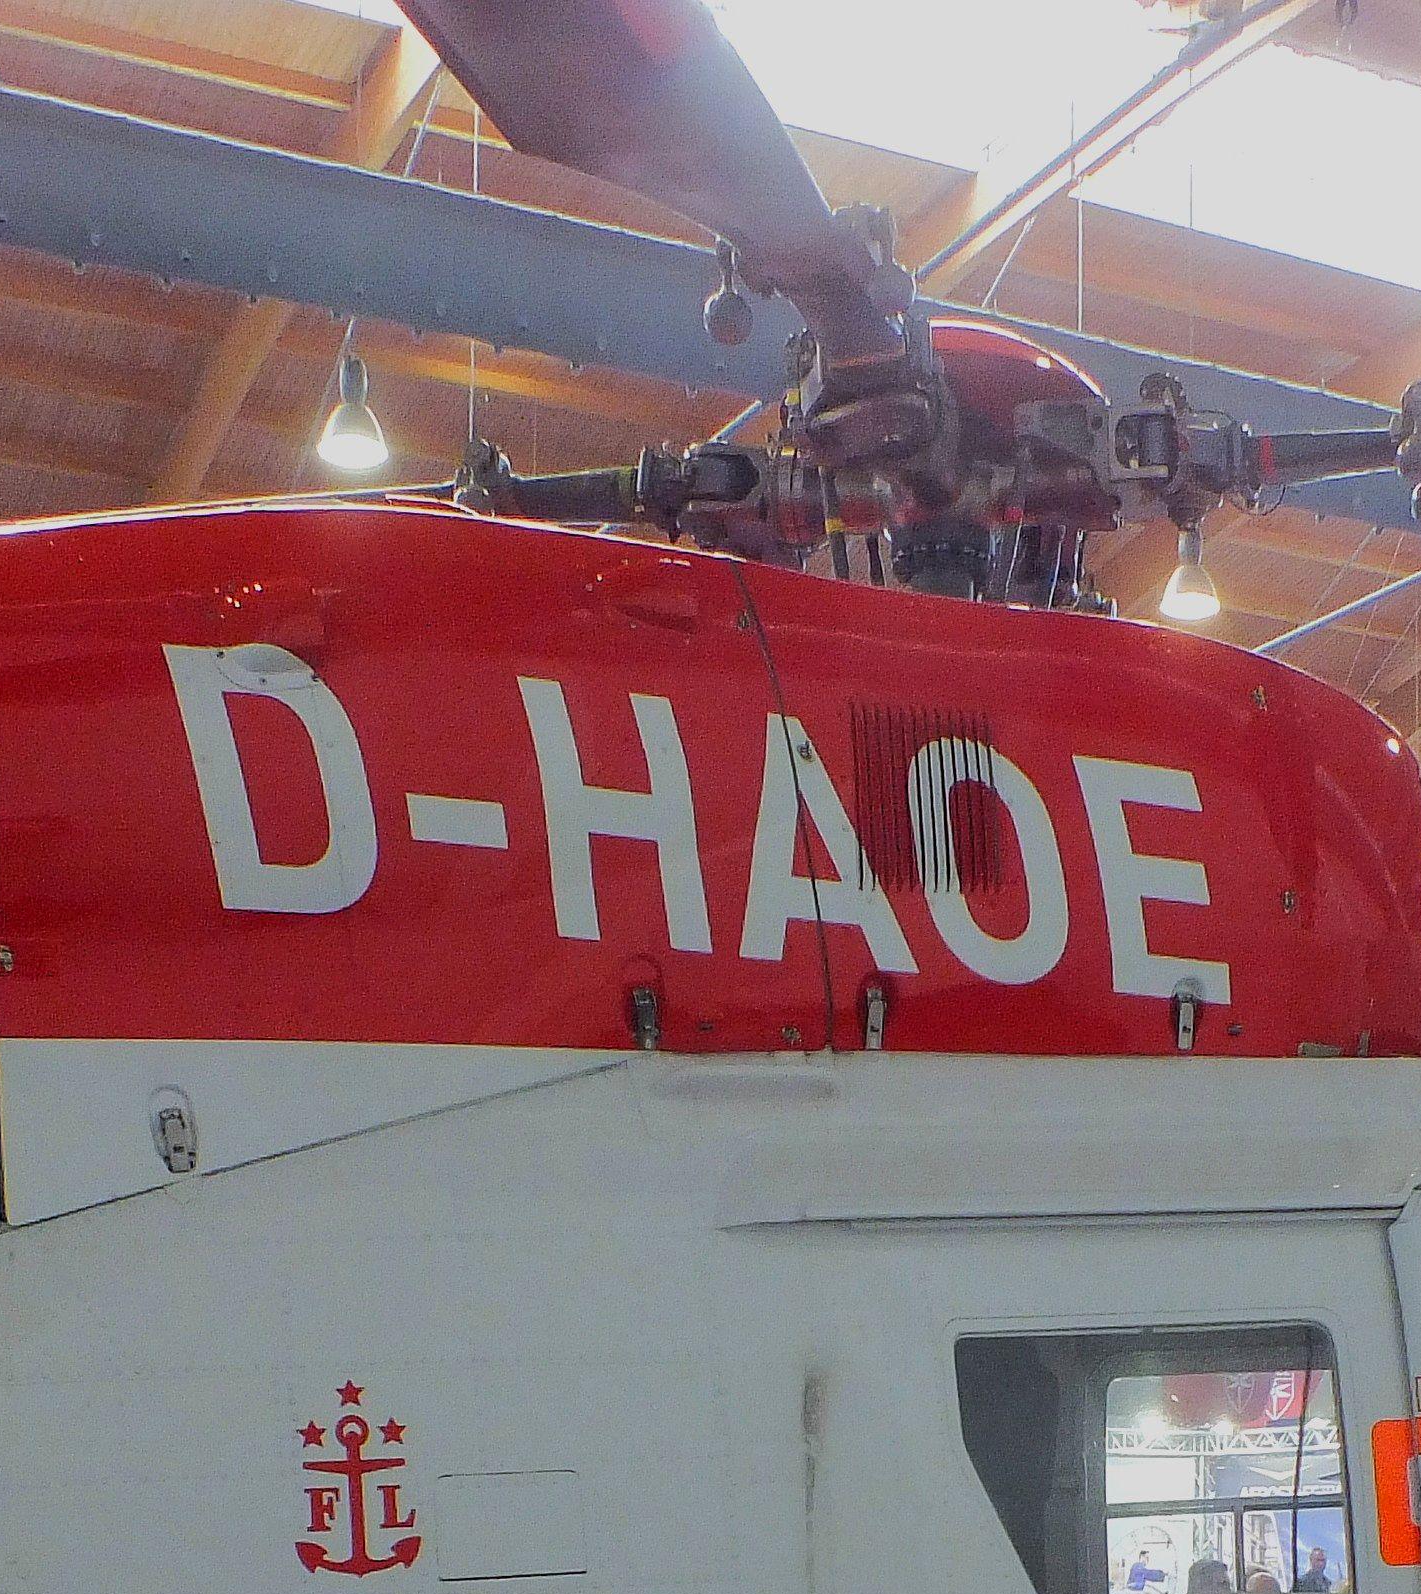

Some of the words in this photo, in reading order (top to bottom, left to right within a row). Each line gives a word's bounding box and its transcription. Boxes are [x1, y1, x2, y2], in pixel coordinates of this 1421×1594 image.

[161, 643, 1232, 1005] D-HAOE
[304, 1487, 340, 1532] F
[377, 1485, 416, 1529] L
